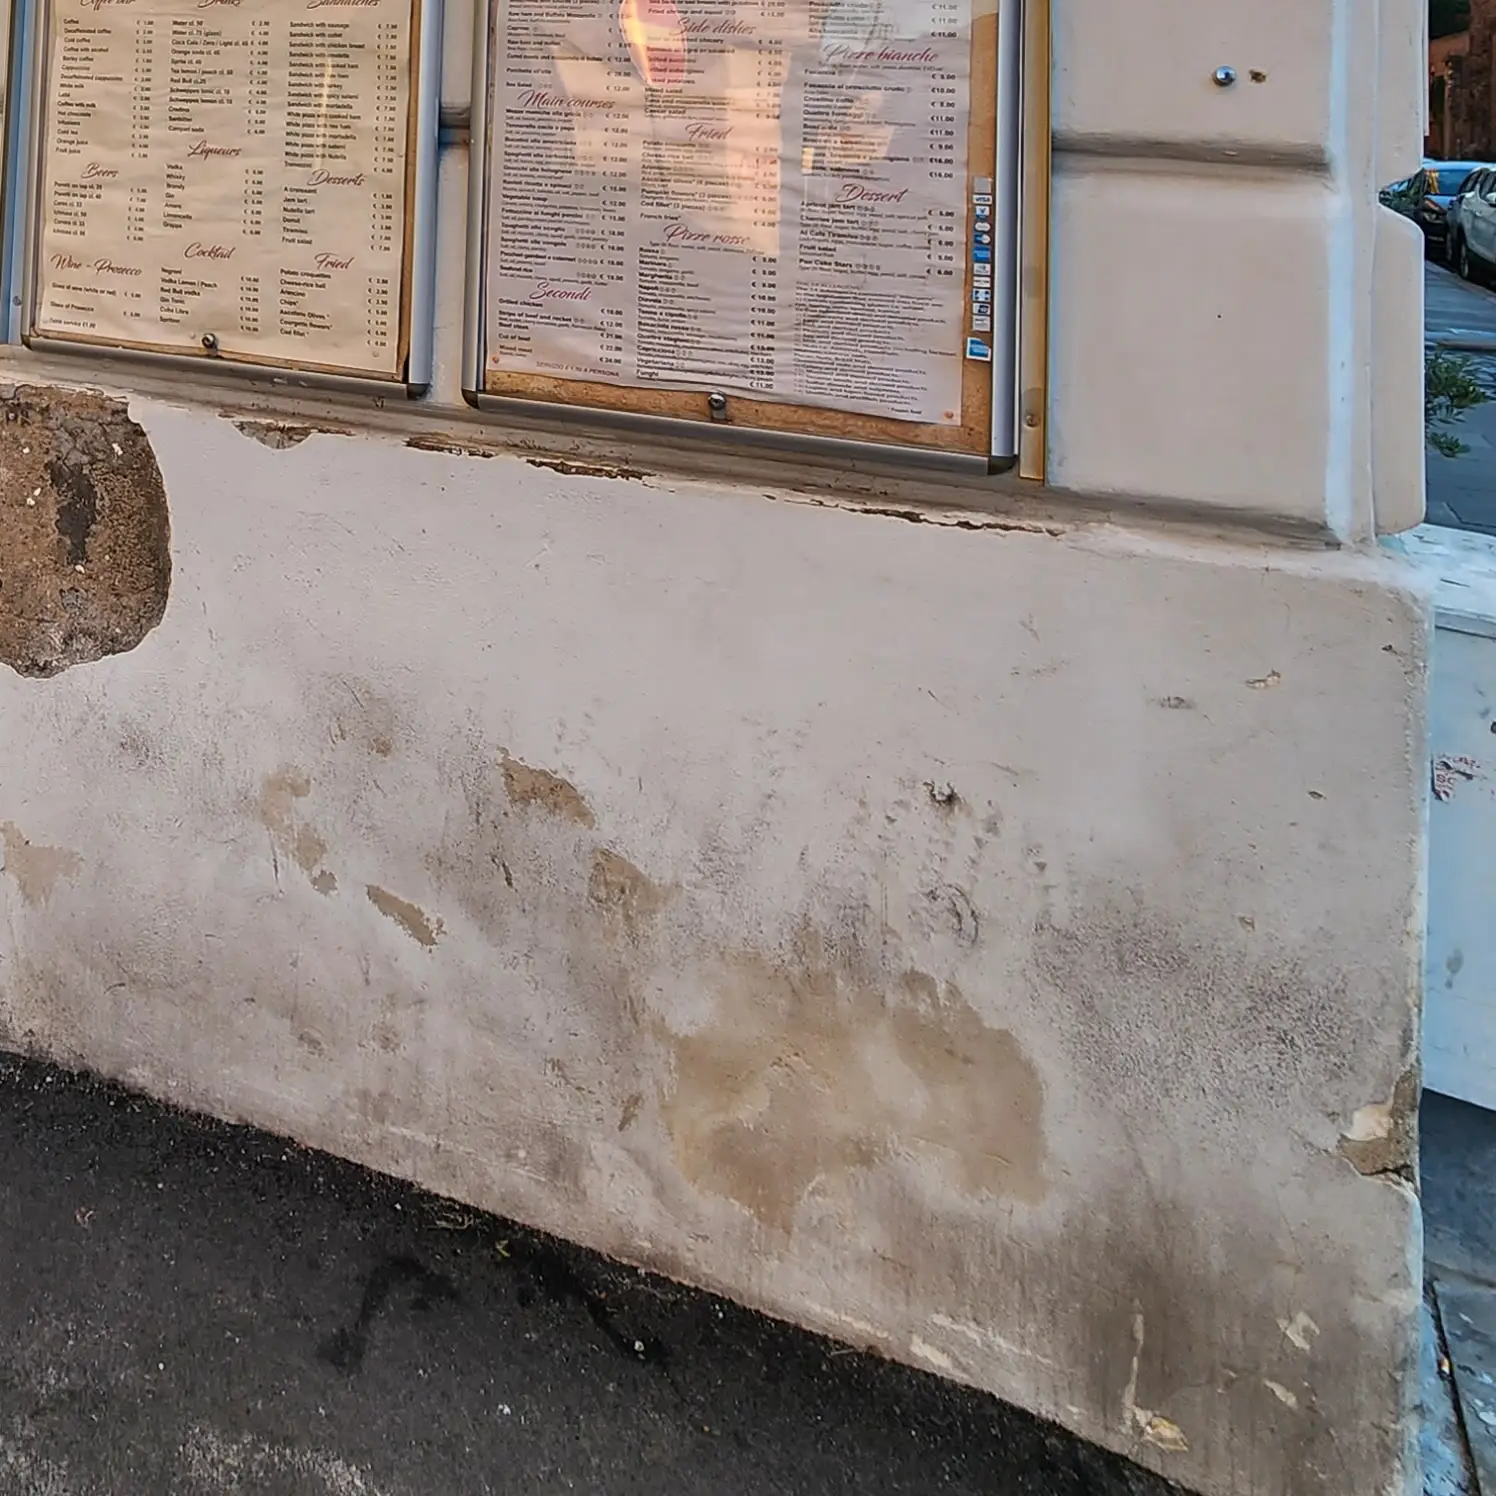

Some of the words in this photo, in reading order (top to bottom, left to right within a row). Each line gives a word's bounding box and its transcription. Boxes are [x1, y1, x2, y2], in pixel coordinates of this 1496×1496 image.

[670, 16, 710, 36] Side
[712, 17, 756, 35] dishes
[877, 46, 939, 63] bianche
[517, 90, 564, 110] Main
[566, 96, 616, 109] courses
[685, 122, 734, 141] Fried
[189, 140, 241, 161] Liqueurs
[81, 162, 119, 179] Beers
[307, 168, 366, 187] Desserts
[835, 183, 910, 203] Dessert
[184, 242, 236, 259] Cocktail
[50, 253, 82, 270] Wine
[94, 259, 142, 276] Prosecco
[314, 252, 354, 270] Fried
[529, 281, 592, 301] Secondi
